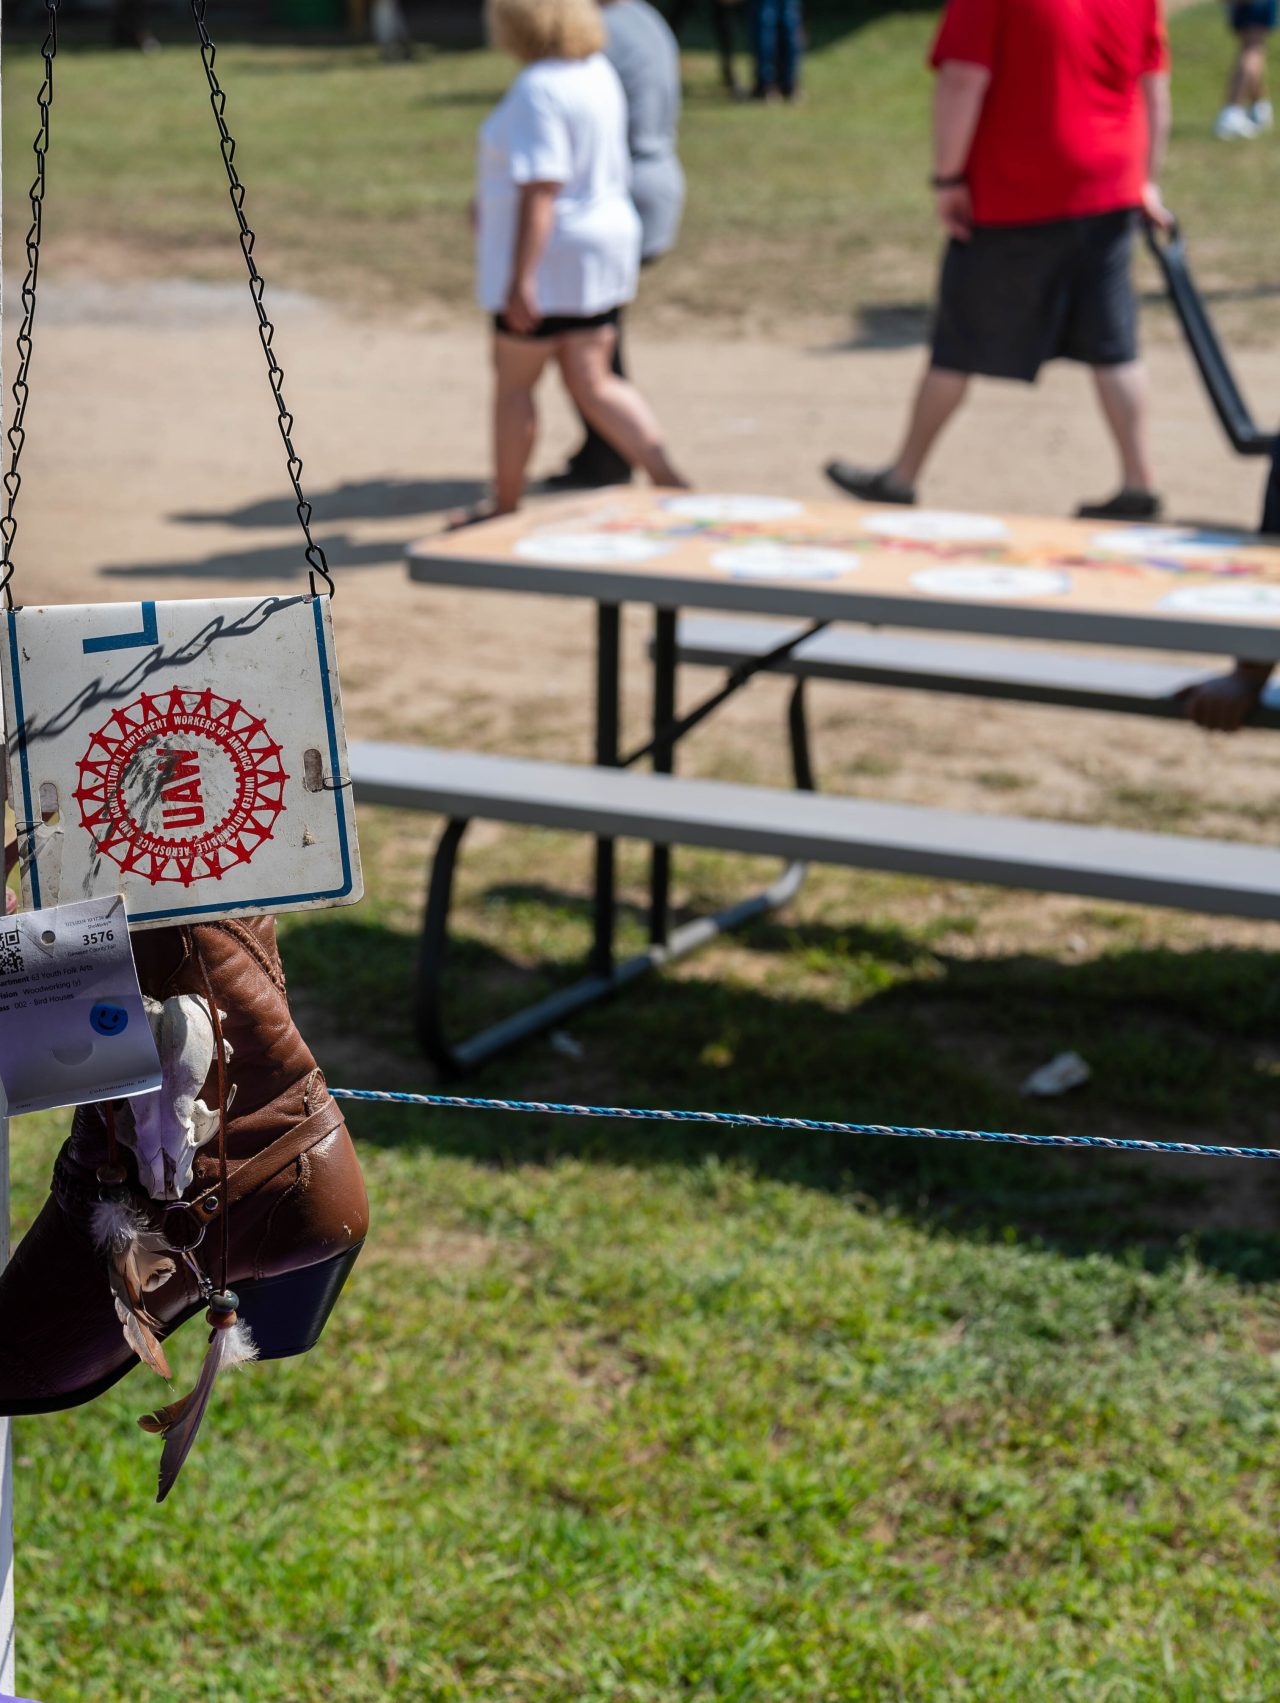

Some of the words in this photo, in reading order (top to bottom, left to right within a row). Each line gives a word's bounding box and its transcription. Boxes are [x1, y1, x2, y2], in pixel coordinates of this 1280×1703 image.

[173, 715, 217, 731] WORKERS
[121, 717, 168, 752] IMPLEMENT
[216, 727, 230, 737] OF
[227, 737, 252, 771] AMERICA
[156, 748, 205, 829] UAW
[239, 776, 256, 813] UNITED
[118, 820, 136, 838] AND
[137, 837, 190, 857] AEROSPACE
[82, 929, 114, 946] 3576
[41, 969, 62, 980] Youth
[63, 967, 78, 976] Folk
[79, 964, 94, 973] Arts
[22, 982, 71, 996] Woodworking
[14, 1001, 28, 1010] 002
[34, 996, 48, 1007] Bird
[49, 993, 74, 1004] Houses
